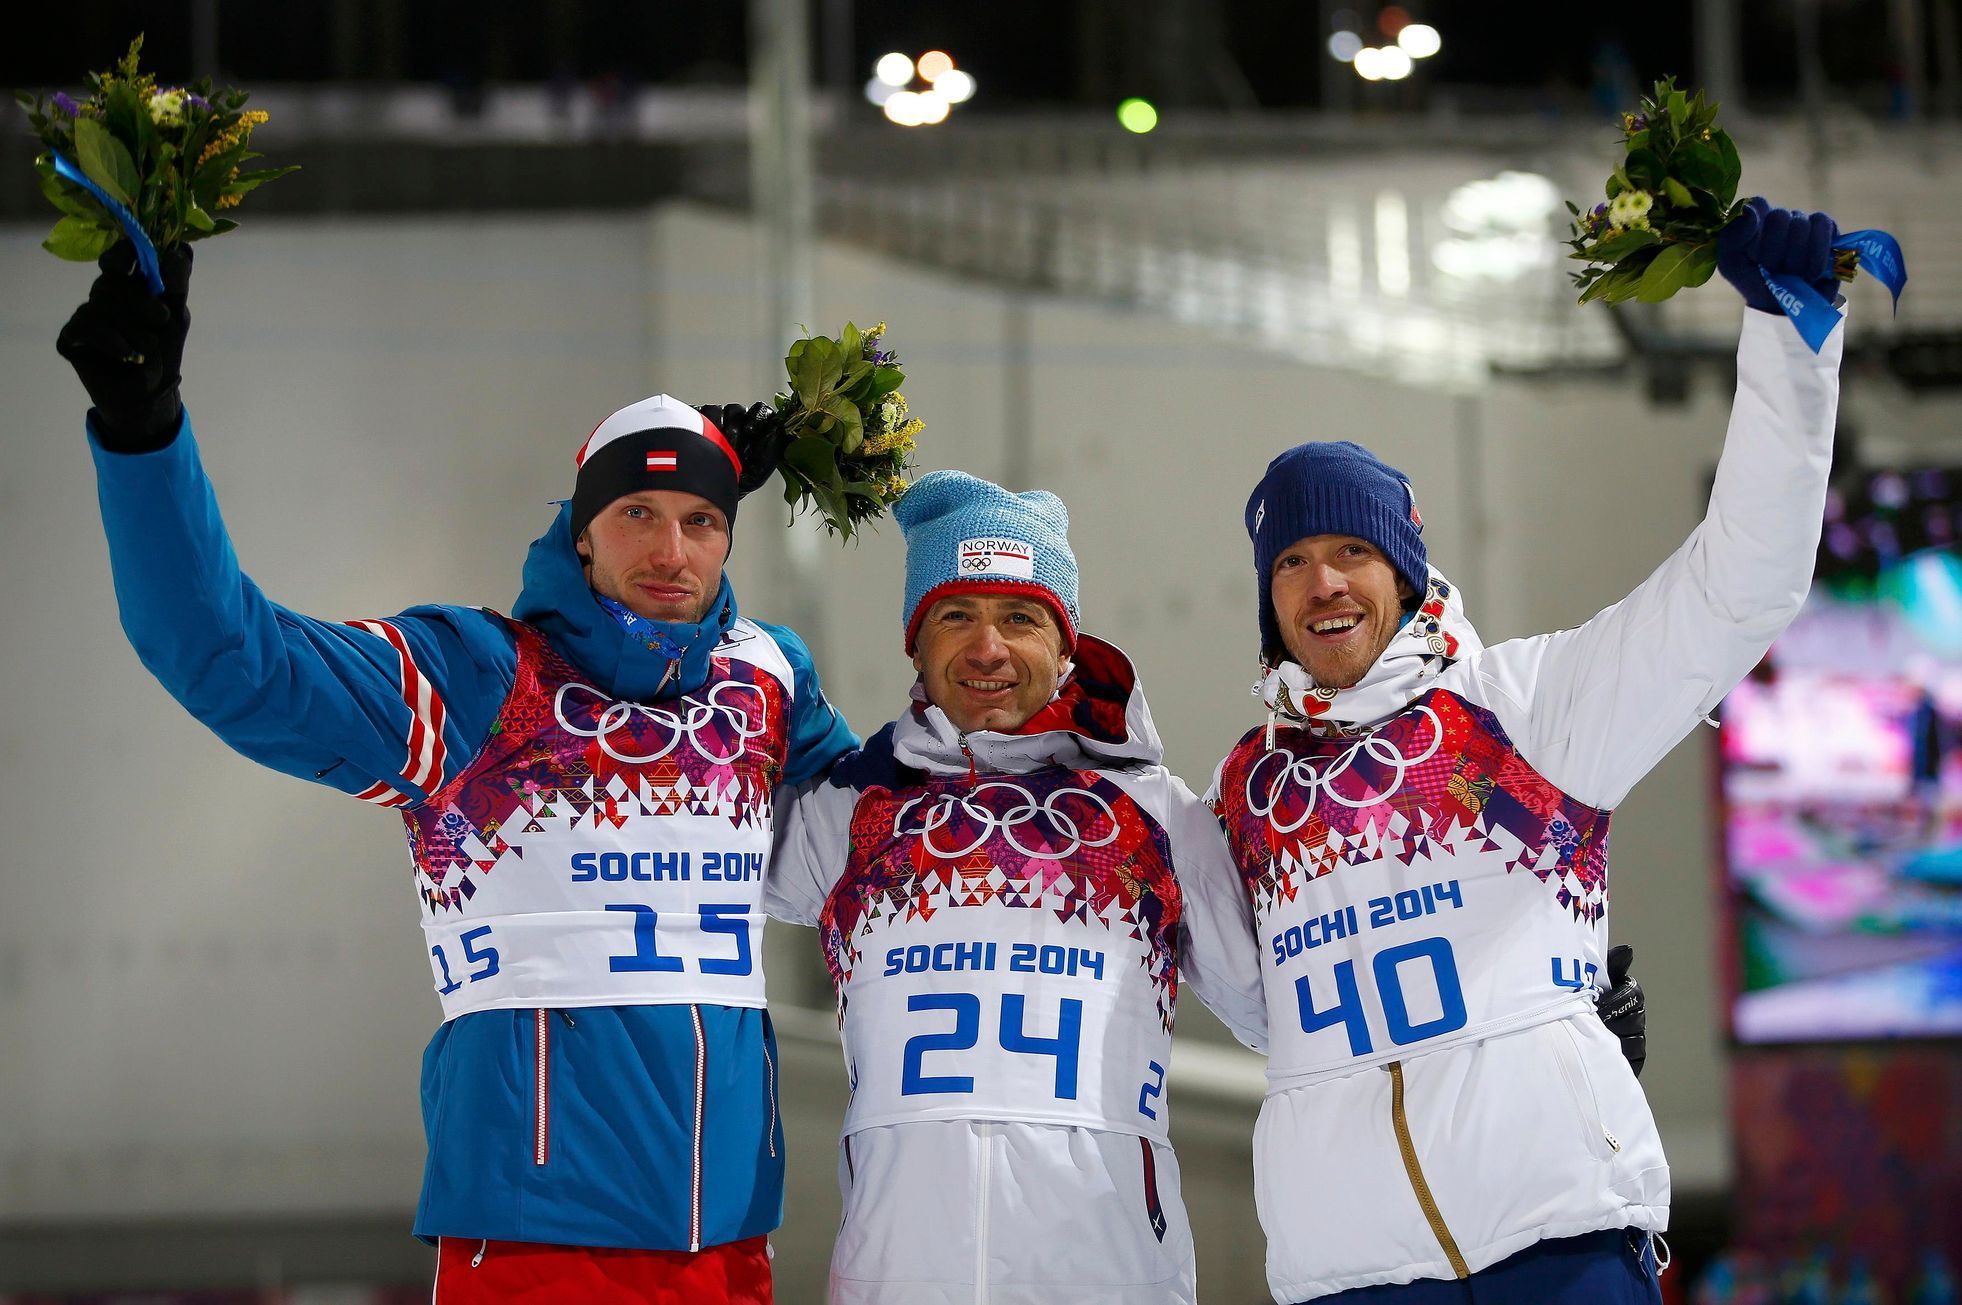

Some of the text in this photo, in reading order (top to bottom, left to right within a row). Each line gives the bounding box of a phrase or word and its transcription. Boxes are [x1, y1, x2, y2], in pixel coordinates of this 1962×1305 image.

[962, 540, 1029, 554] NORWAY
[571, 852, 763, 882] SOCHI 2014
[604, 903, 753, 977] 15
[1272, 879, 1464, 967] SOCHI 2014
[431, 925, 501, 996] 15
[883, 942, 1105, 981] SOCHI 2014
[1294, 935, 1468, 1057] 40
[901, 993, 1083, 1101] 24
